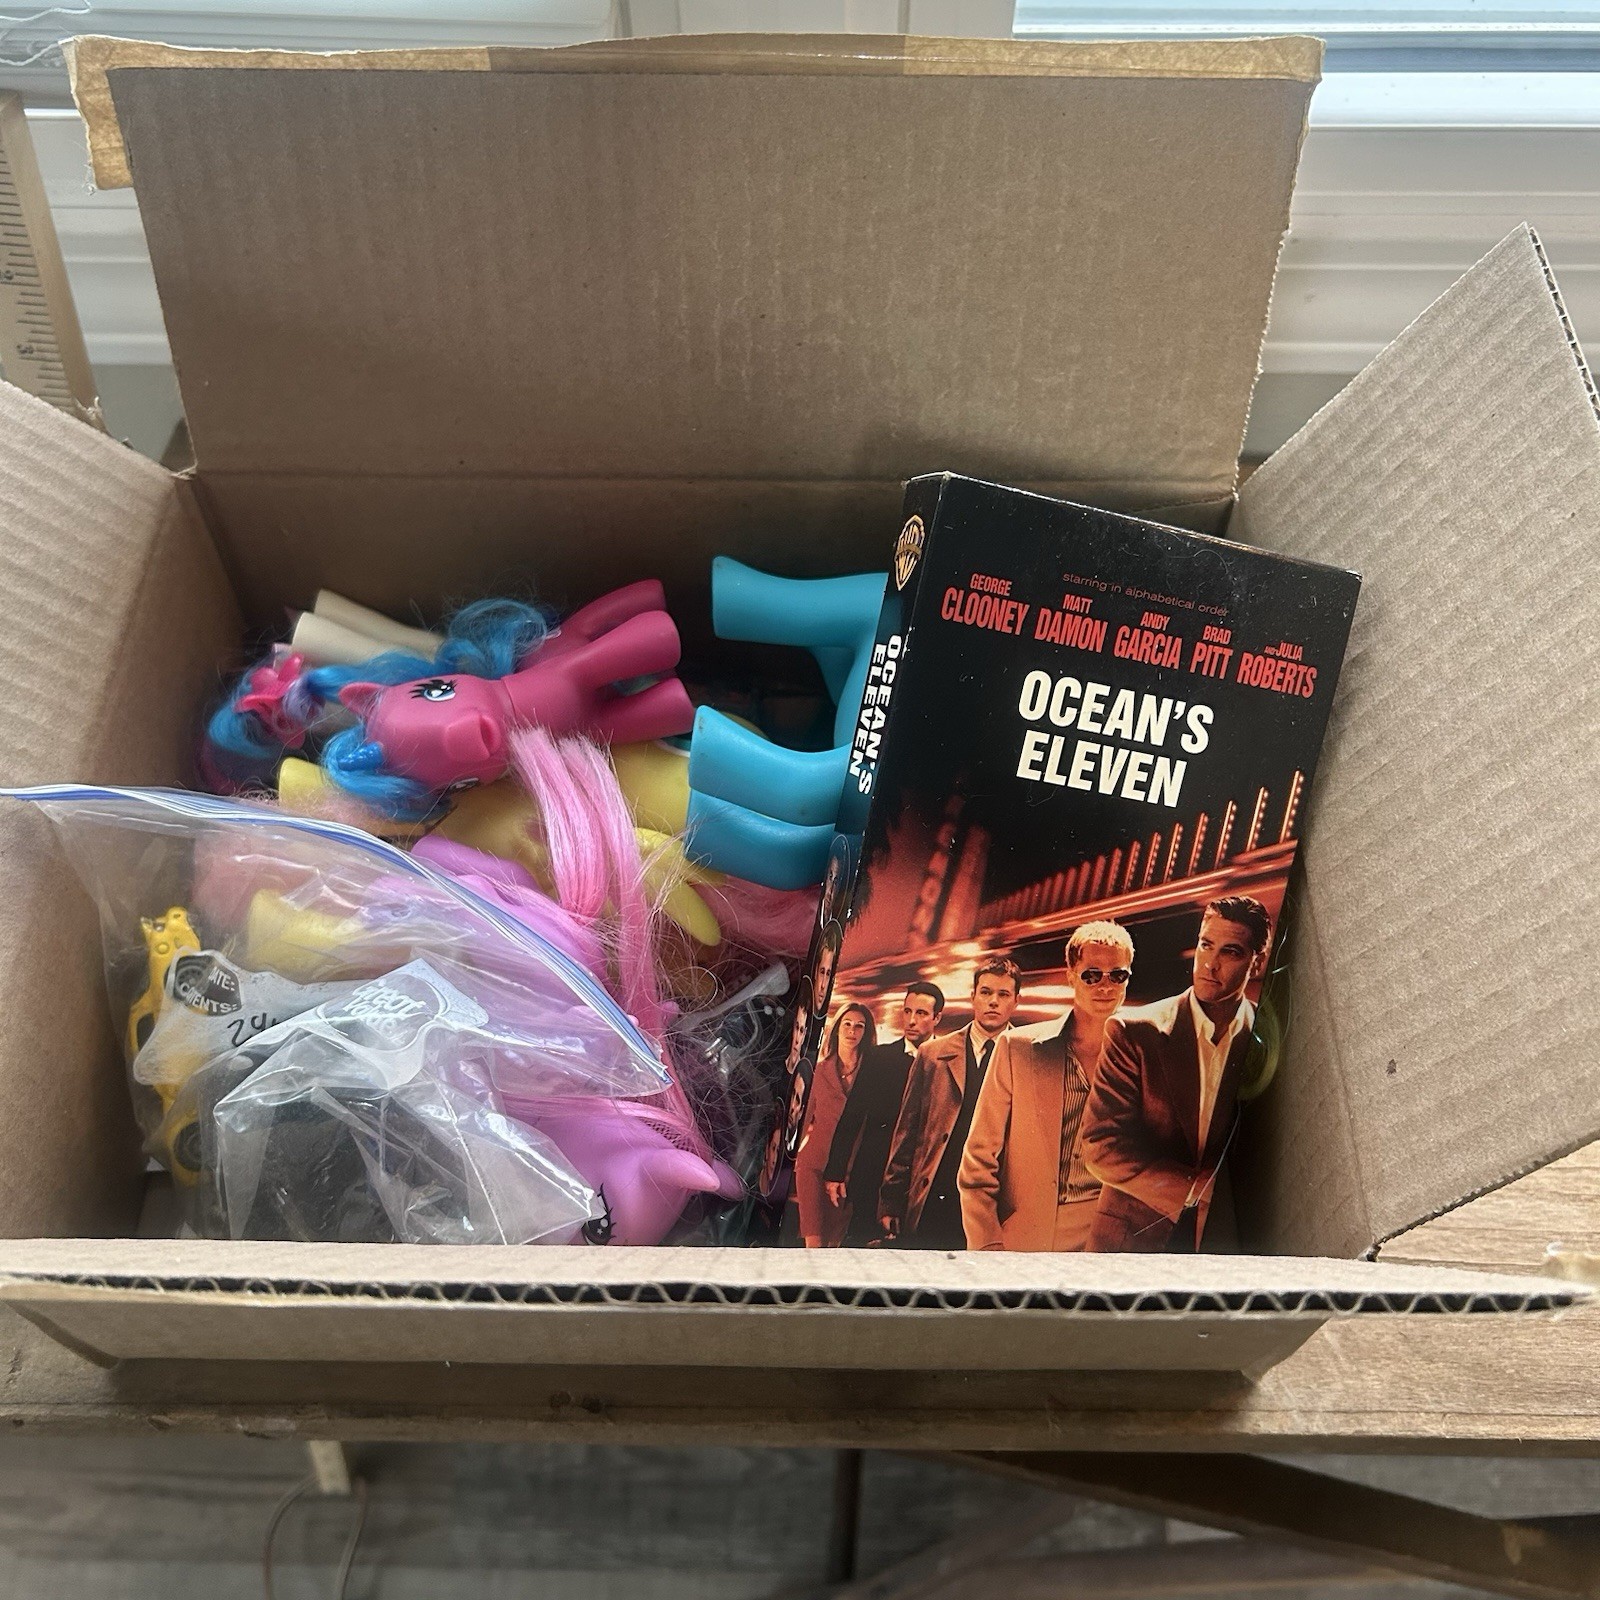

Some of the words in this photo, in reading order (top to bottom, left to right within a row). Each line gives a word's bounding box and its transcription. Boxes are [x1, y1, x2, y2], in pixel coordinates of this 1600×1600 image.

[969, 573, 1013, 597] GEORGE
[1062, 572, 1107, 592] starring
[1110, 583, 1122, 593] in
[1125, 586, 1195, 609] alphabetical
[1197, 604, 1229, 617] order
[1062, 593, 1093, 614] MATT
[941, 587, 1031, 636] CLOONEY
[1034, 607, 1109, 654] DAMON
[1140, 611, 1171, 632] ANDY
[1202, 624, 1232, 645] BRAD
[1113, 624, 1183, 670] GARCIA
[1189, 642, 1234, 680] PITT
[1276, 640, 1304, 661] JULIA
[1236, 651, 1318, 699] ROBERTS
[849, 643, 887, 777] ELEVEN
[859, 634, 902, 795] OCEAN'S
[1018, 669, 1215, 754] OCEAN'S
[1016, 729, 1188, 808] ELEVEN
